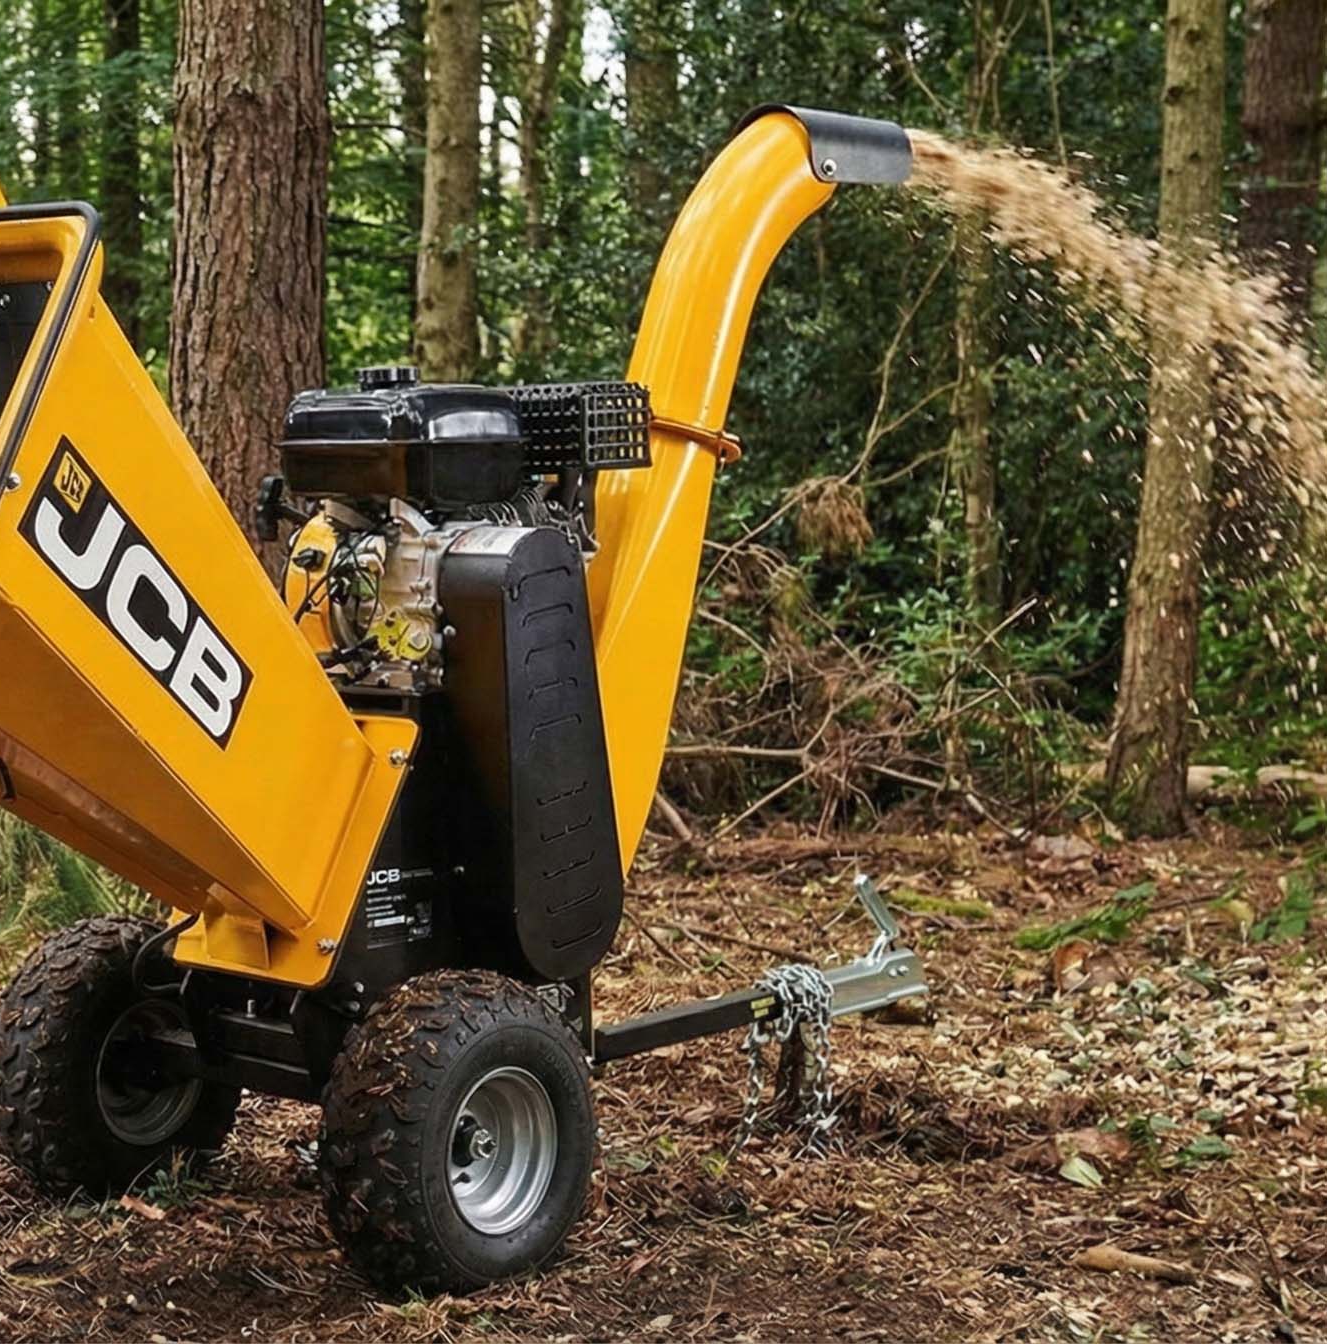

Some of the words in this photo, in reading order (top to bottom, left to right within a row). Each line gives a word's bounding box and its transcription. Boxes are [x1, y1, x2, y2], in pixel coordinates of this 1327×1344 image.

[60, 462, 84, 503] JCB
[35, 496, 242, 737] JCB
[366, 868, 400, 885] JCB
